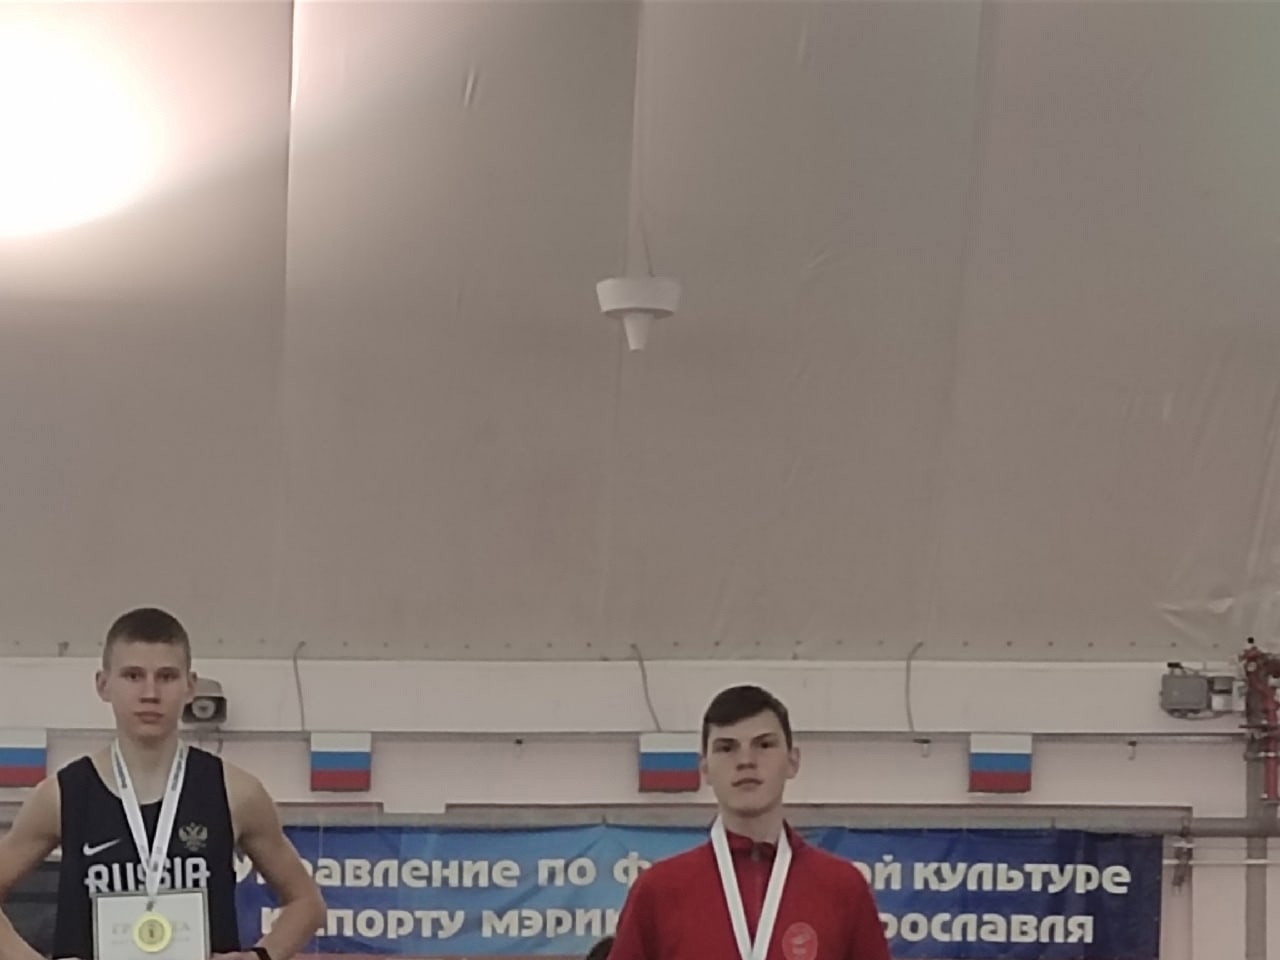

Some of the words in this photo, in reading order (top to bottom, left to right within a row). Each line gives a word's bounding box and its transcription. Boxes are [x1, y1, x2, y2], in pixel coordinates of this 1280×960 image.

[537, 857, 597, 887] по
[913, 861, 1132, 894] культуре
[315, 907, 465, 940] порту
[878, 912, 1094, 944] рославля
